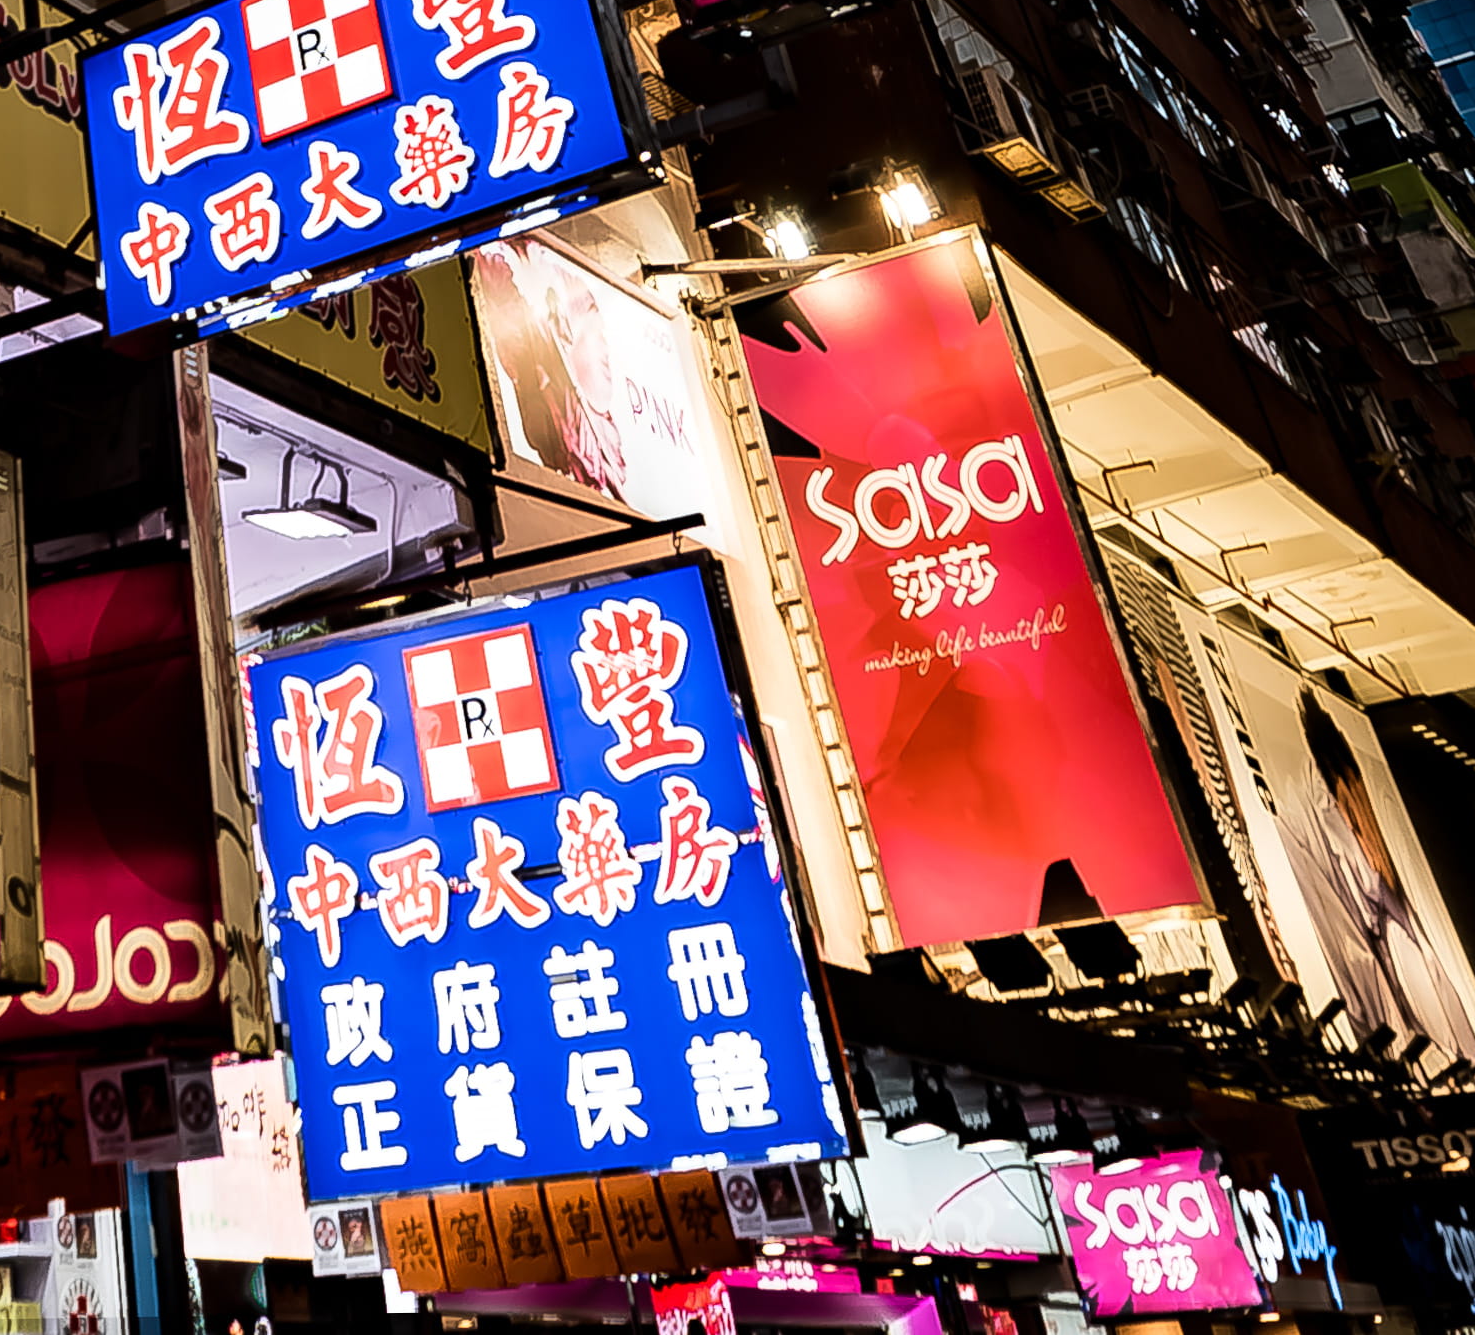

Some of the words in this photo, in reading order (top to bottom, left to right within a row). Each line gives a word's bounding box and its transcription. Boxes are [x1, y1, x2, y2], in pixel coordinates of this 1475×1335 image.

[119, 61, 574, 306] 中西大藥房
[863, 637, 933, 679] making
[934, 617, 977, 671] life
[978, 602, 1068, 654] beautiful
[886, 540, 999, 622] 莎莎
[286, 775, 740, 968] 中西大藥房
[320, 922, 751, 1069] 政府註冊
[330, 1030, 779, 1173] 正貨保證
[395, 1188, 721, 1274] 燕窩蟲草批發
